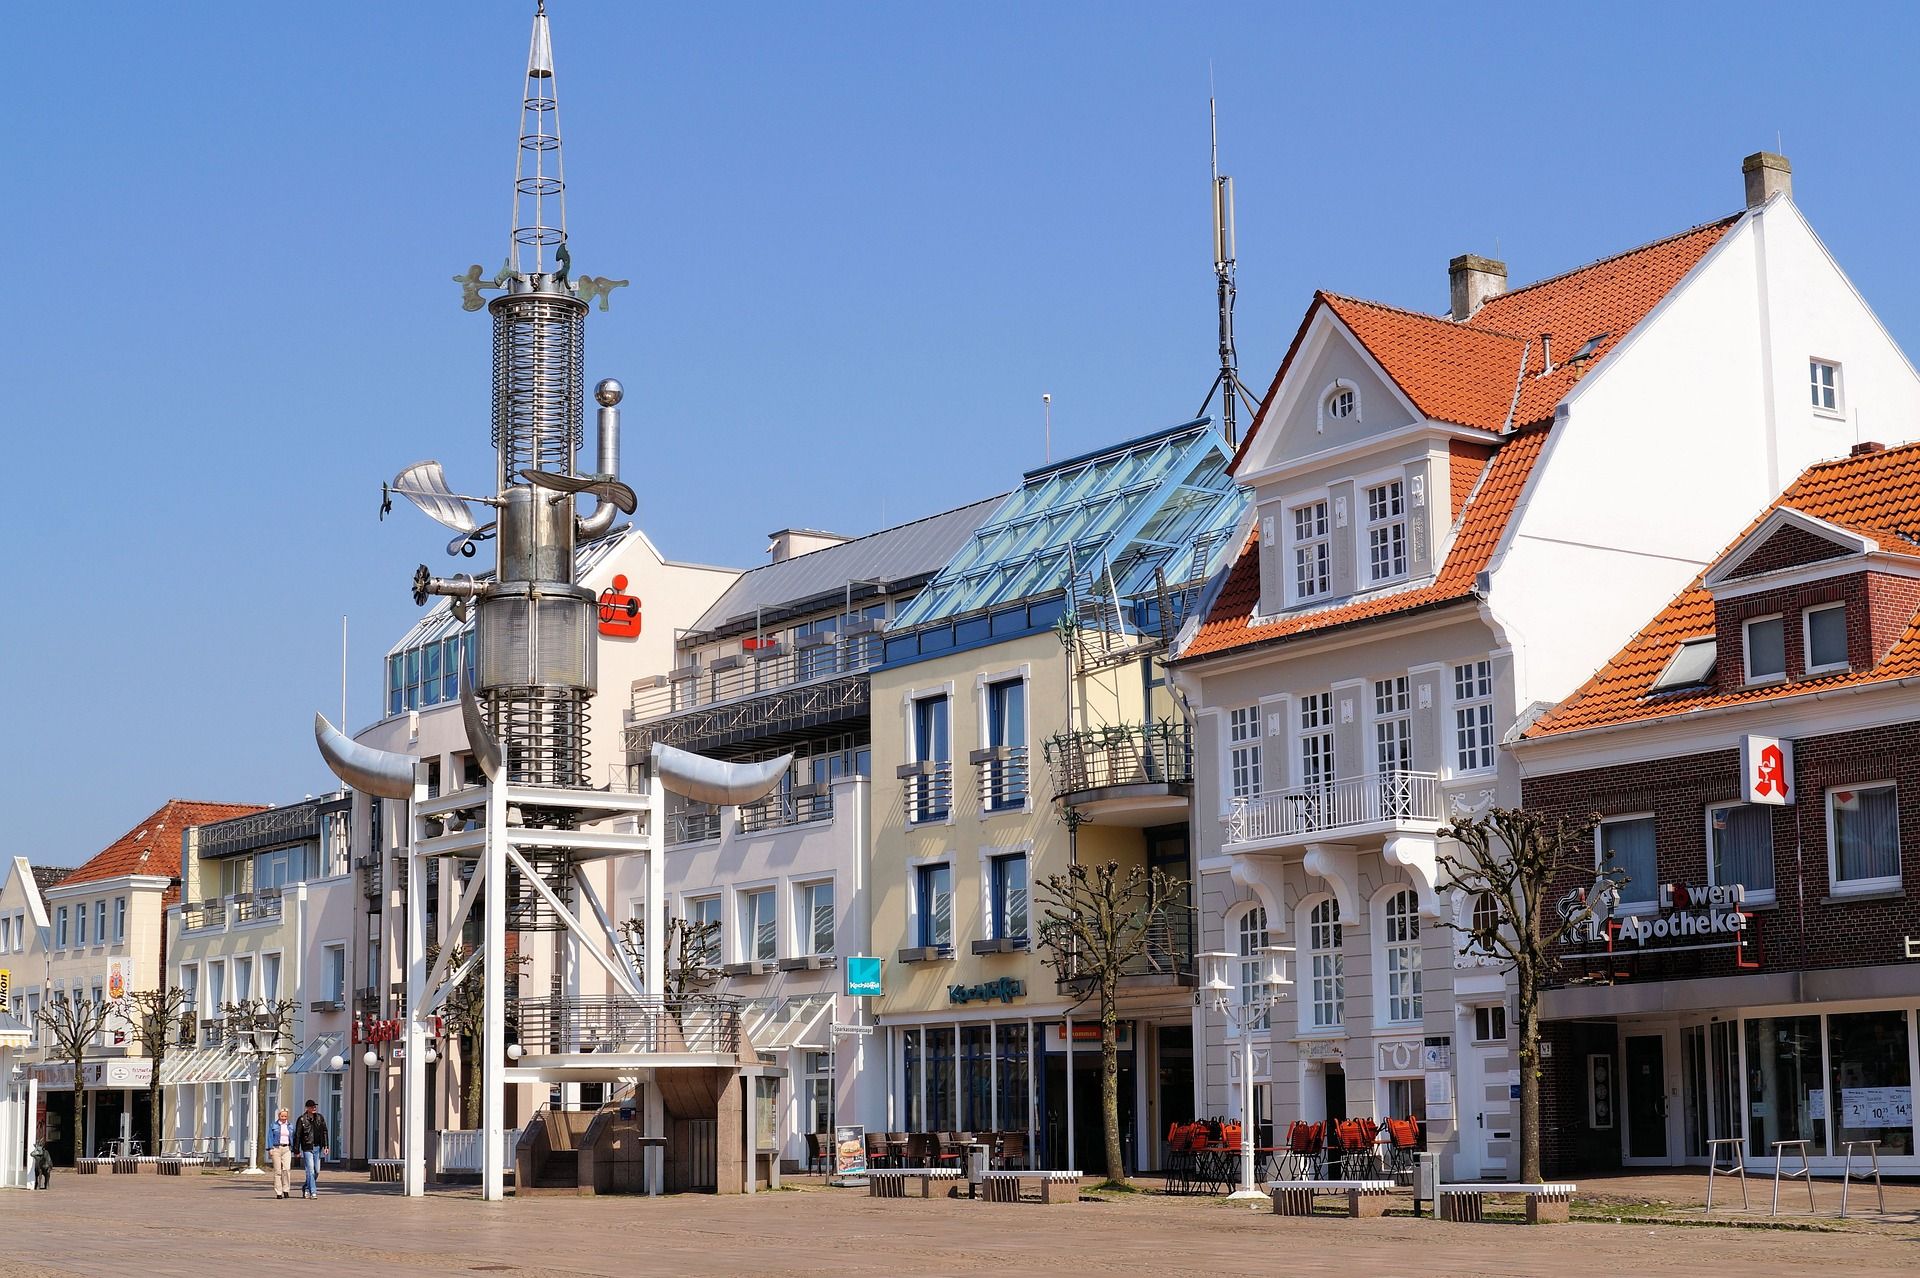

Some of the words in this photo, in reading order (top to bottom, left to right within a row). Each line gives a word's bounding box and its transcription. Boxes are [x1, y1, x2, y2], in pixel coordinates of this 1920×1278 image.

[1660, 882, 1745, 909] Löwen
[1618, 909, 1746, 947] Apotheke
[0, 974, 8, 1007] Nikon
[834, 1025, 873, 1034] Sparkassenpassage
